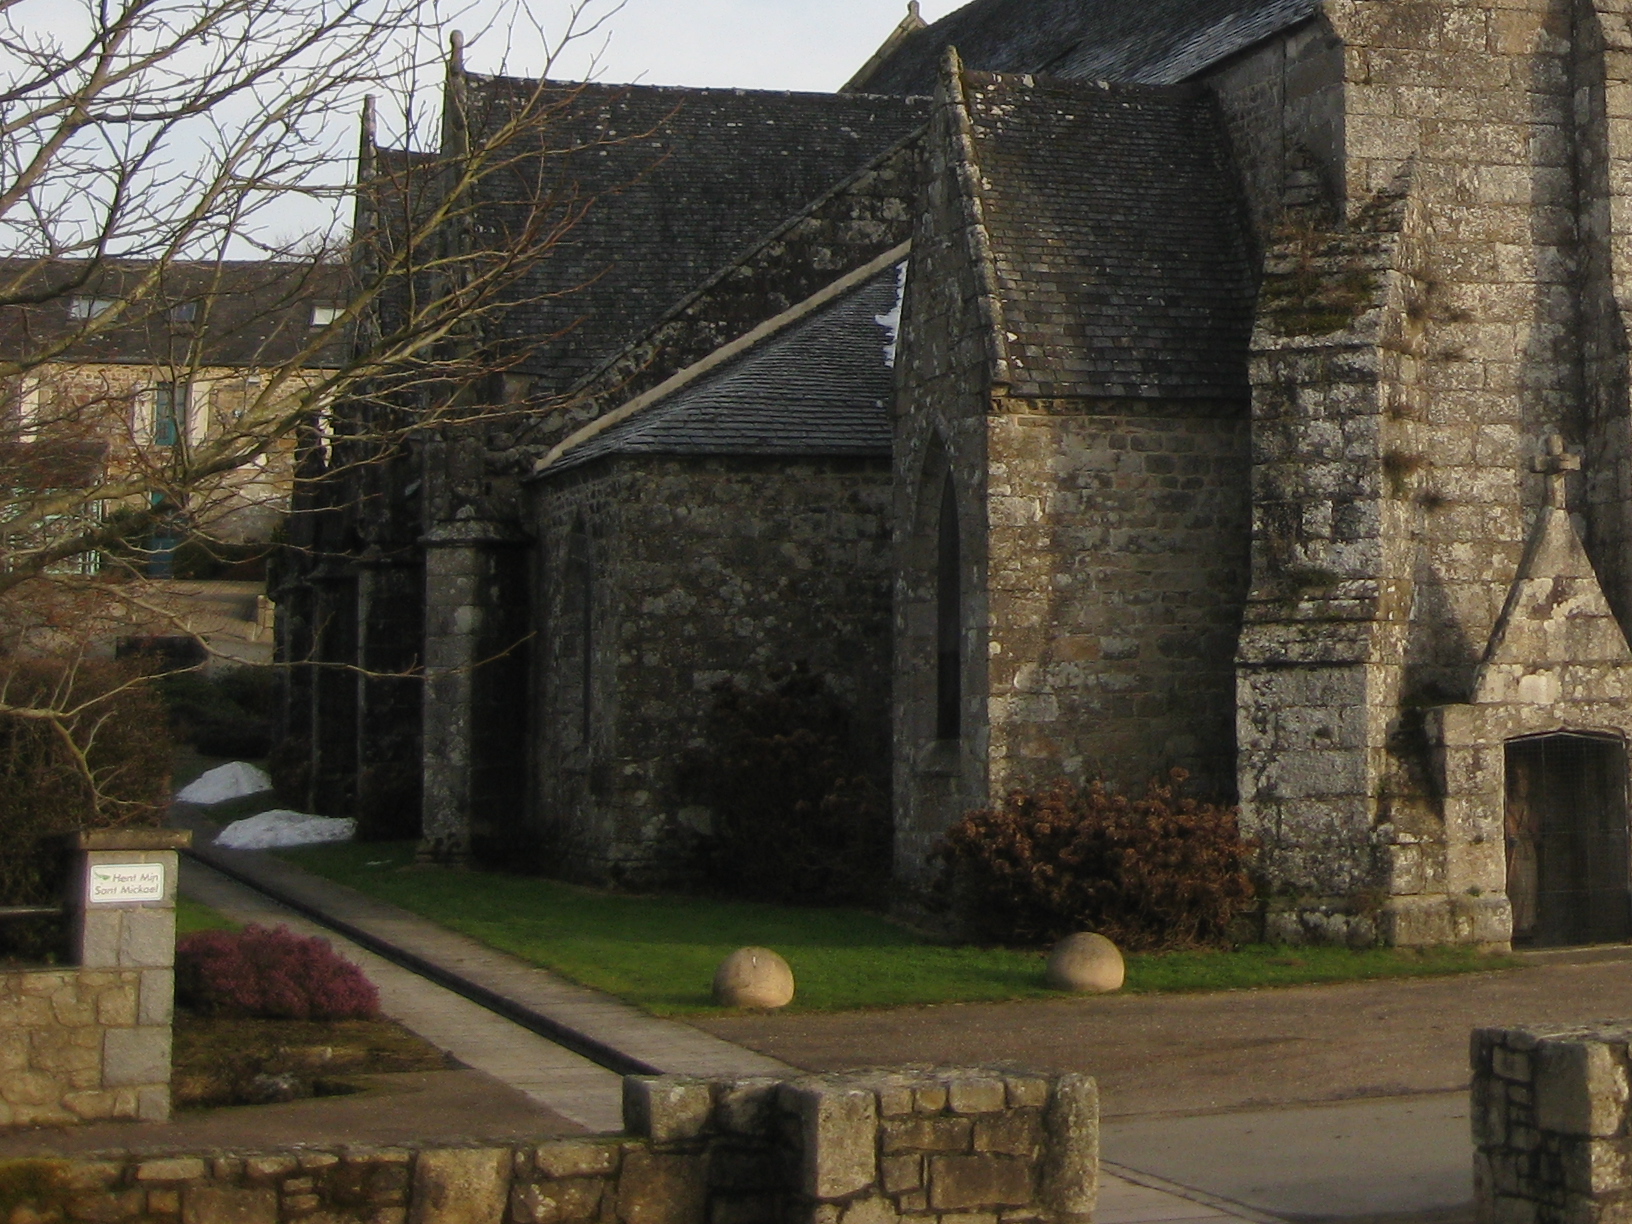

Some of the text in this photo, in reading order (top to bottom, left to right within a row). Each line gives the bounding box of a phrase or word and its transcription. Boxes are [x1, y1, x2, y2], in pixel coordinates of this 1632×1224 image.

[112, 873, 136, 883] Hent
[94, 884, 159, 895] Sant Mickael
